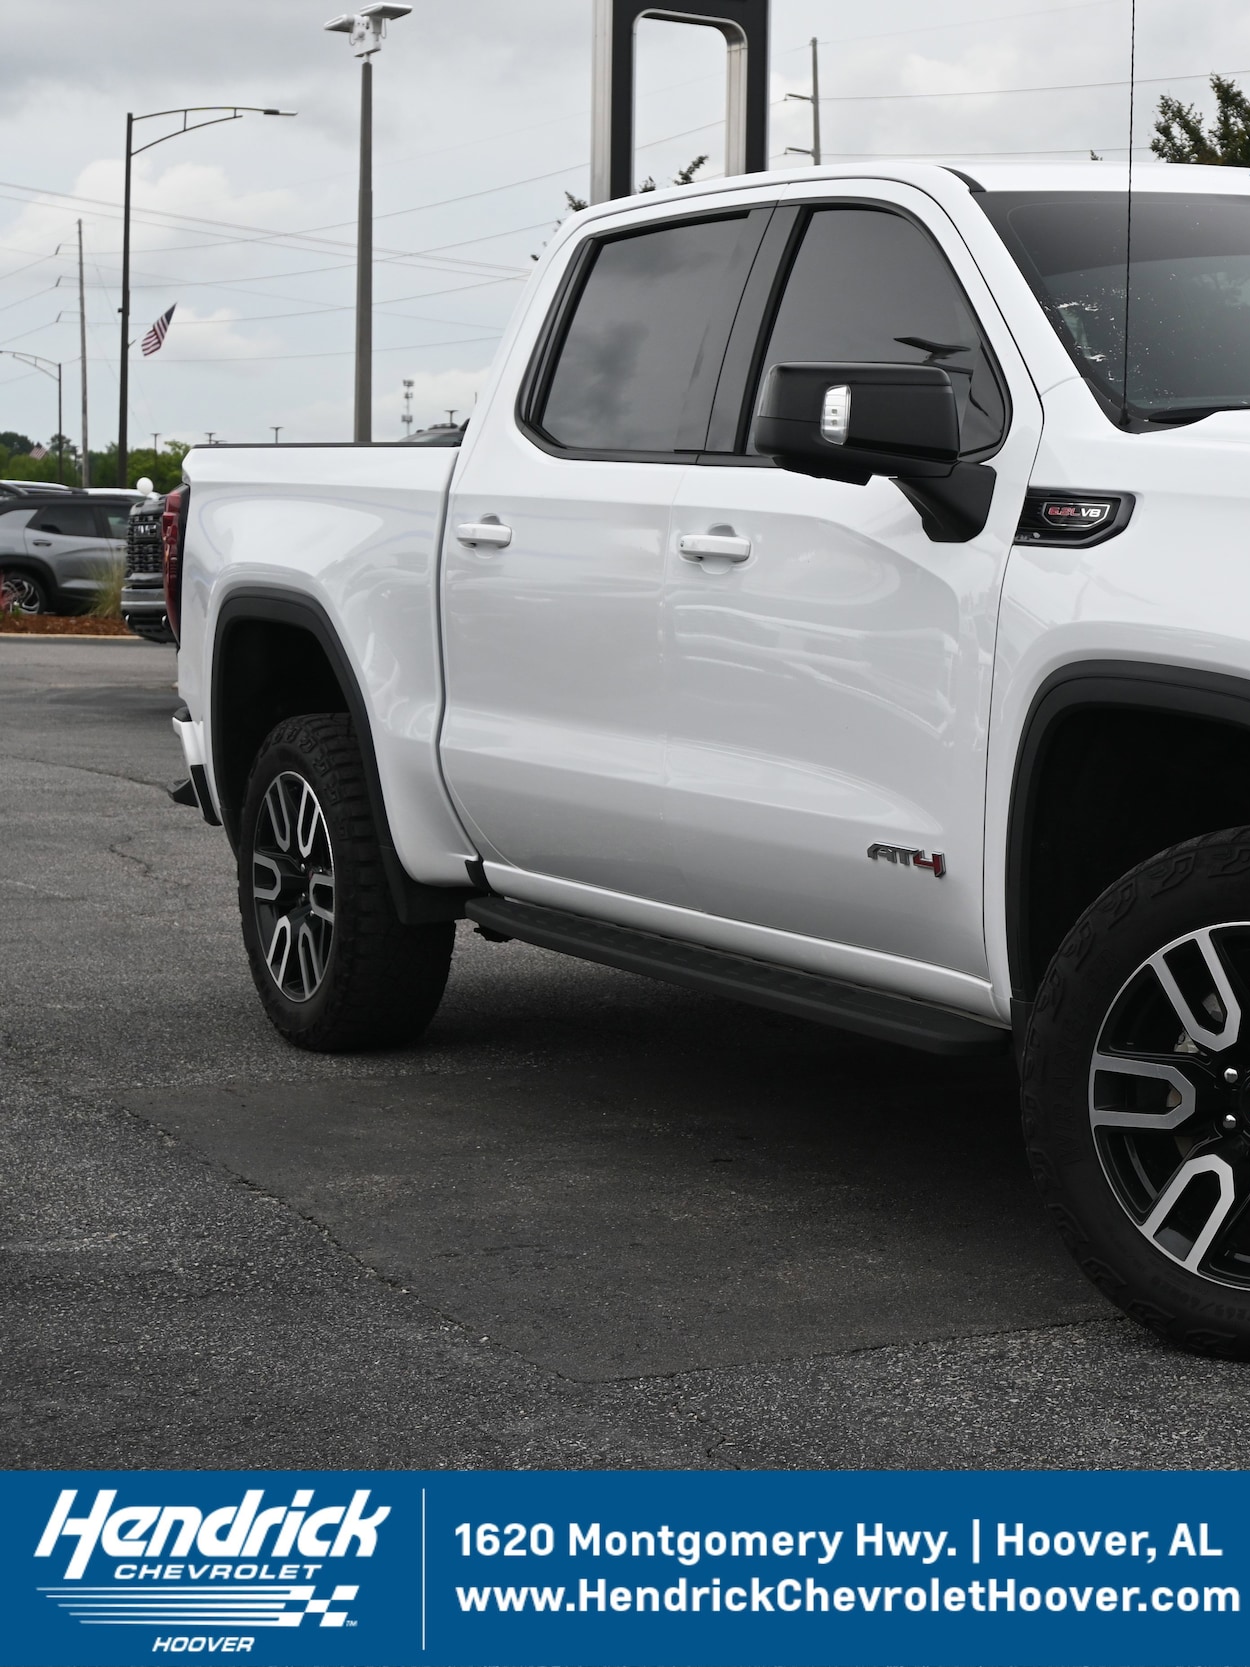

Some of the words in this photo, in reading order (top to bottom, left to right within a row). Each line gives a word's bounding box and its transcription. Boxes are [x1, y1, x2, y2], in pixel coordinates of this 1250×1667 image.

[1048, 506, 1080, 517] 6.2L
[1081, 507, 1102, 518] V8
[867, 841, 946, 878] AT4
